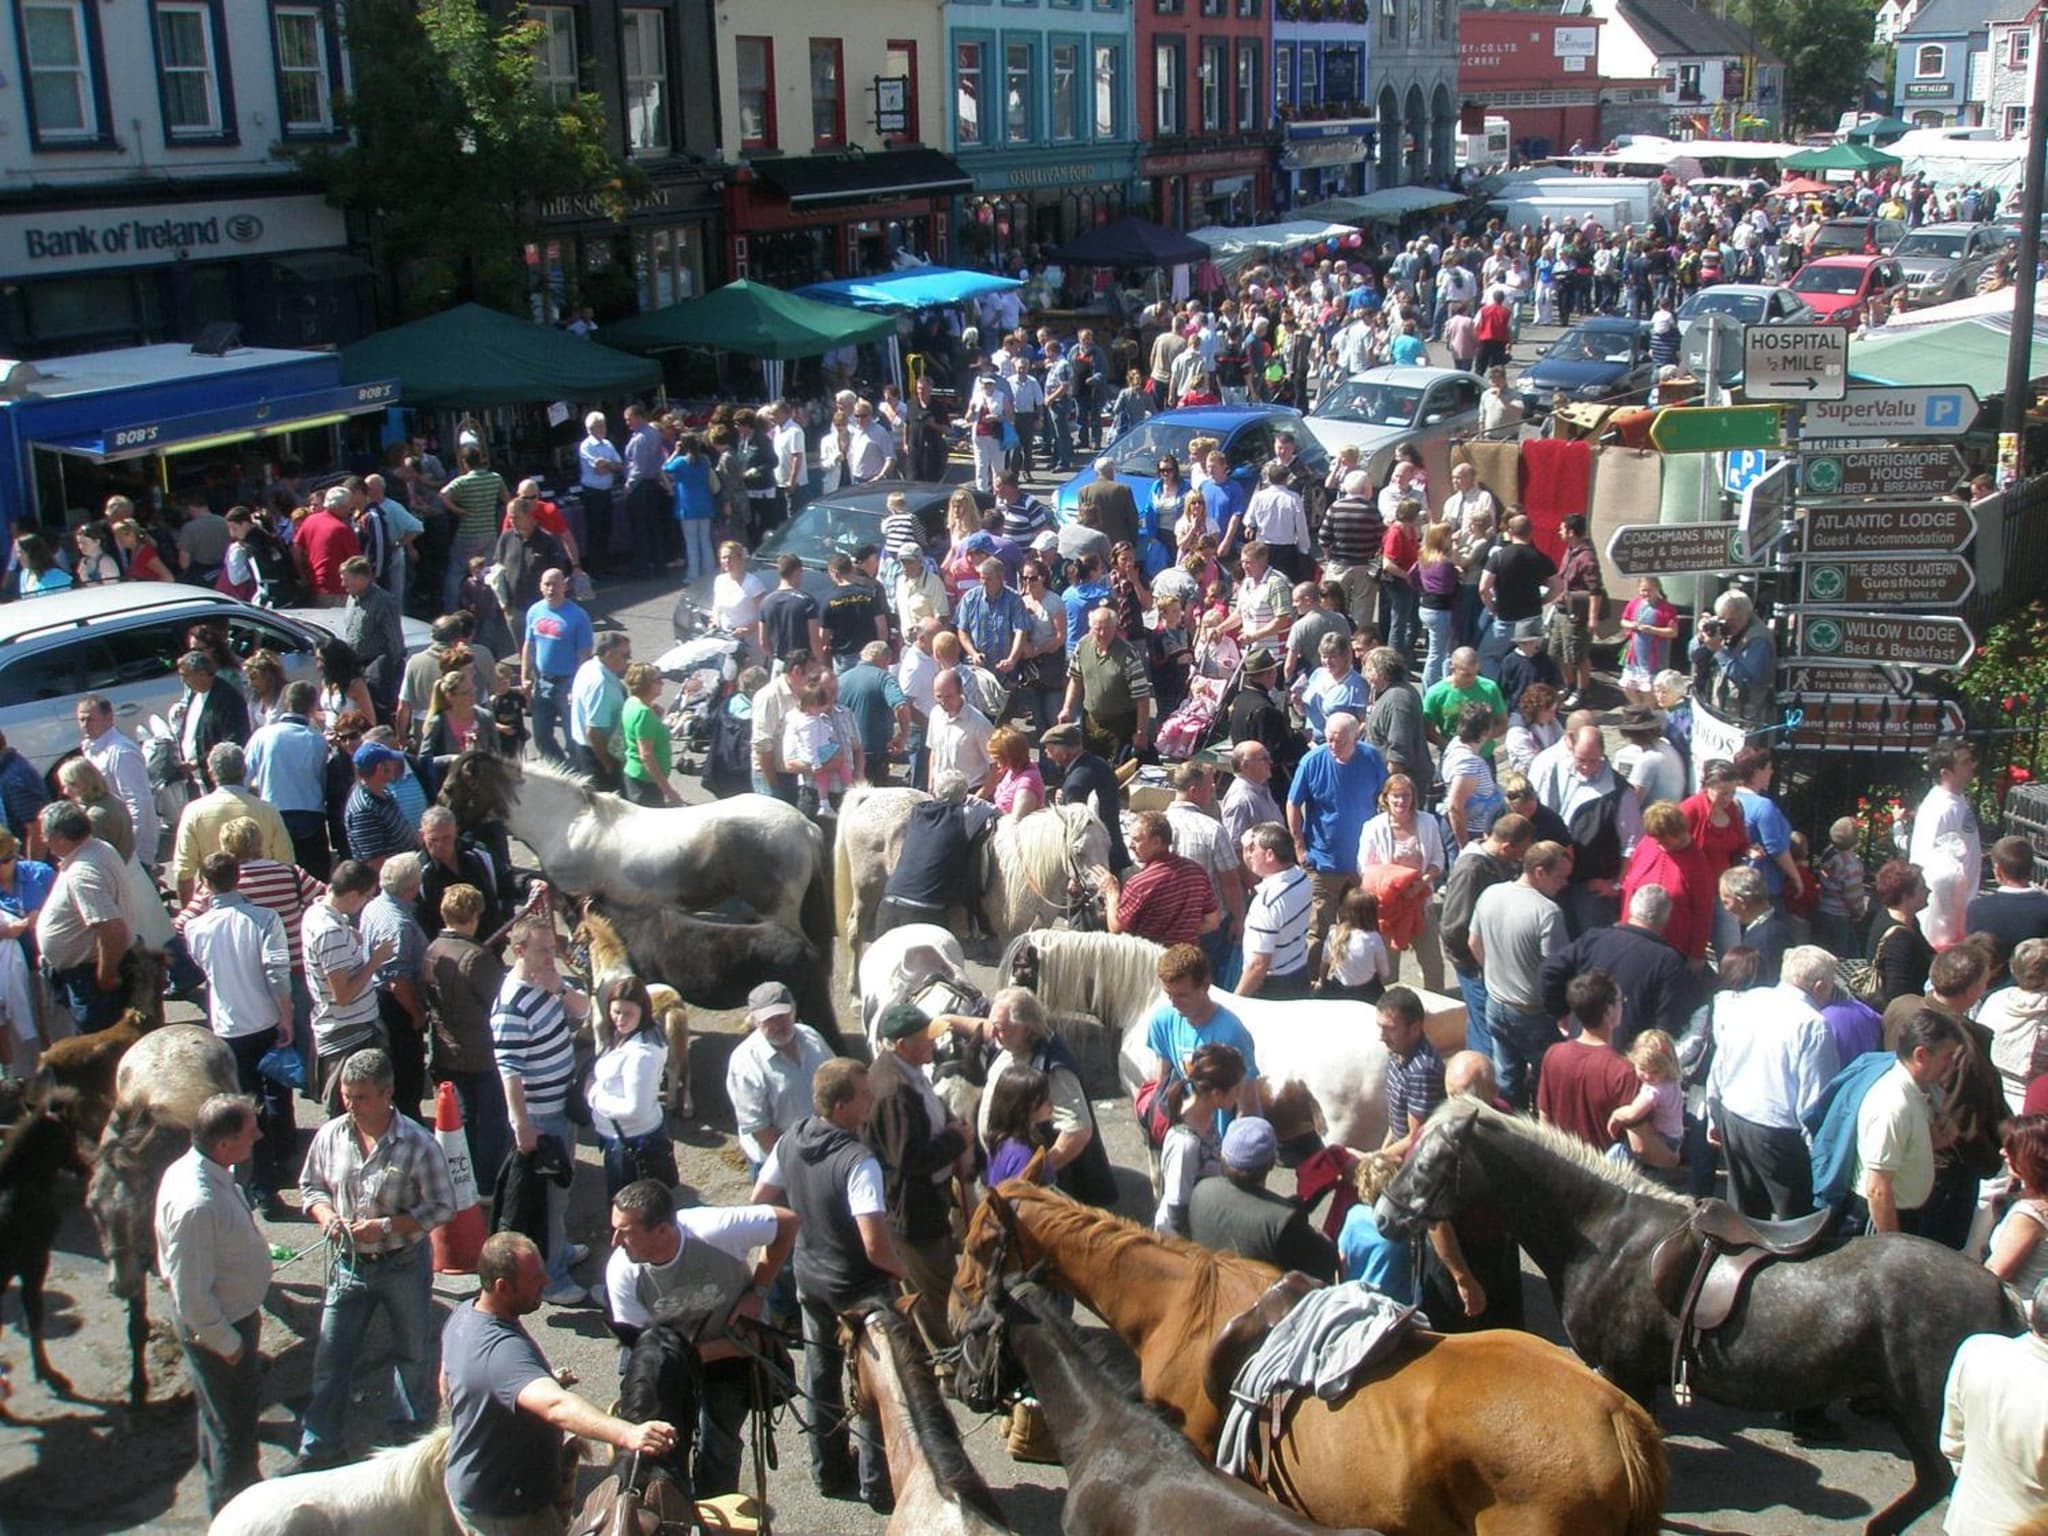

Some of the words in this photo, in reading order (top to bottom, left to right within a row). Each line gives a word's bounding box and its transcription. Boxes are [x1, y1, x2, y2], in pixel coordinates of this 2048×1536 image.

[24, 225, 99, 259] Bank
[101, 222, 131, 253] of
[132, 215, 220, 251] Ireland
[1751, 333, 1842, 350] HOSPITAL
[1782, 355, 1825, 372] MILE
[357, 384, 393, 400] BOB'S
[1815, 400, 1916, 424] SuperValu
[115, 426, 160, 446] BOB'S
[1846, 453, 1950, 468] CARRIGMORE
[1869, 467, 1924, 480] HOUSE
[1844, 482, 1866, 494] BED
[1871, 481, 1879, 493] &
[1883, 480, 1947, 493] BREAKFAST
[1815, 513, 1893, 529] ATLANTIC
[1900, 512, 1958, 527] LODGE
[1623, 530, 1700, 545] COACHMANS
[1704, 527, 1725, 541] INN
[1813, 533, 1850, 546] Guest
[1854, 532, 1955, 546] Accommodation
[1631, 546, 1654, 559] Bed
[1658, 545, 1666, 557] &
[1671, 543, 1724, 556] Breakfast
[1665, 558, 1724, 569] Restaurant
[1850, 563, 1869, 577] THE
[1871, 562, 1907, 577] BRASS
[1909, 562, 1957, 576] LANTERN
[1861, 577, 1947, 589] Guesthouse
[1846, 621, 1903, 638] WILLOW
[1907, 626, 1958, 643] LODGE
[1844, 640, 1870, 656] Bed
[1874, 643, 1885, 656] &
[1890, 645, 1955, 661] Breakfast
